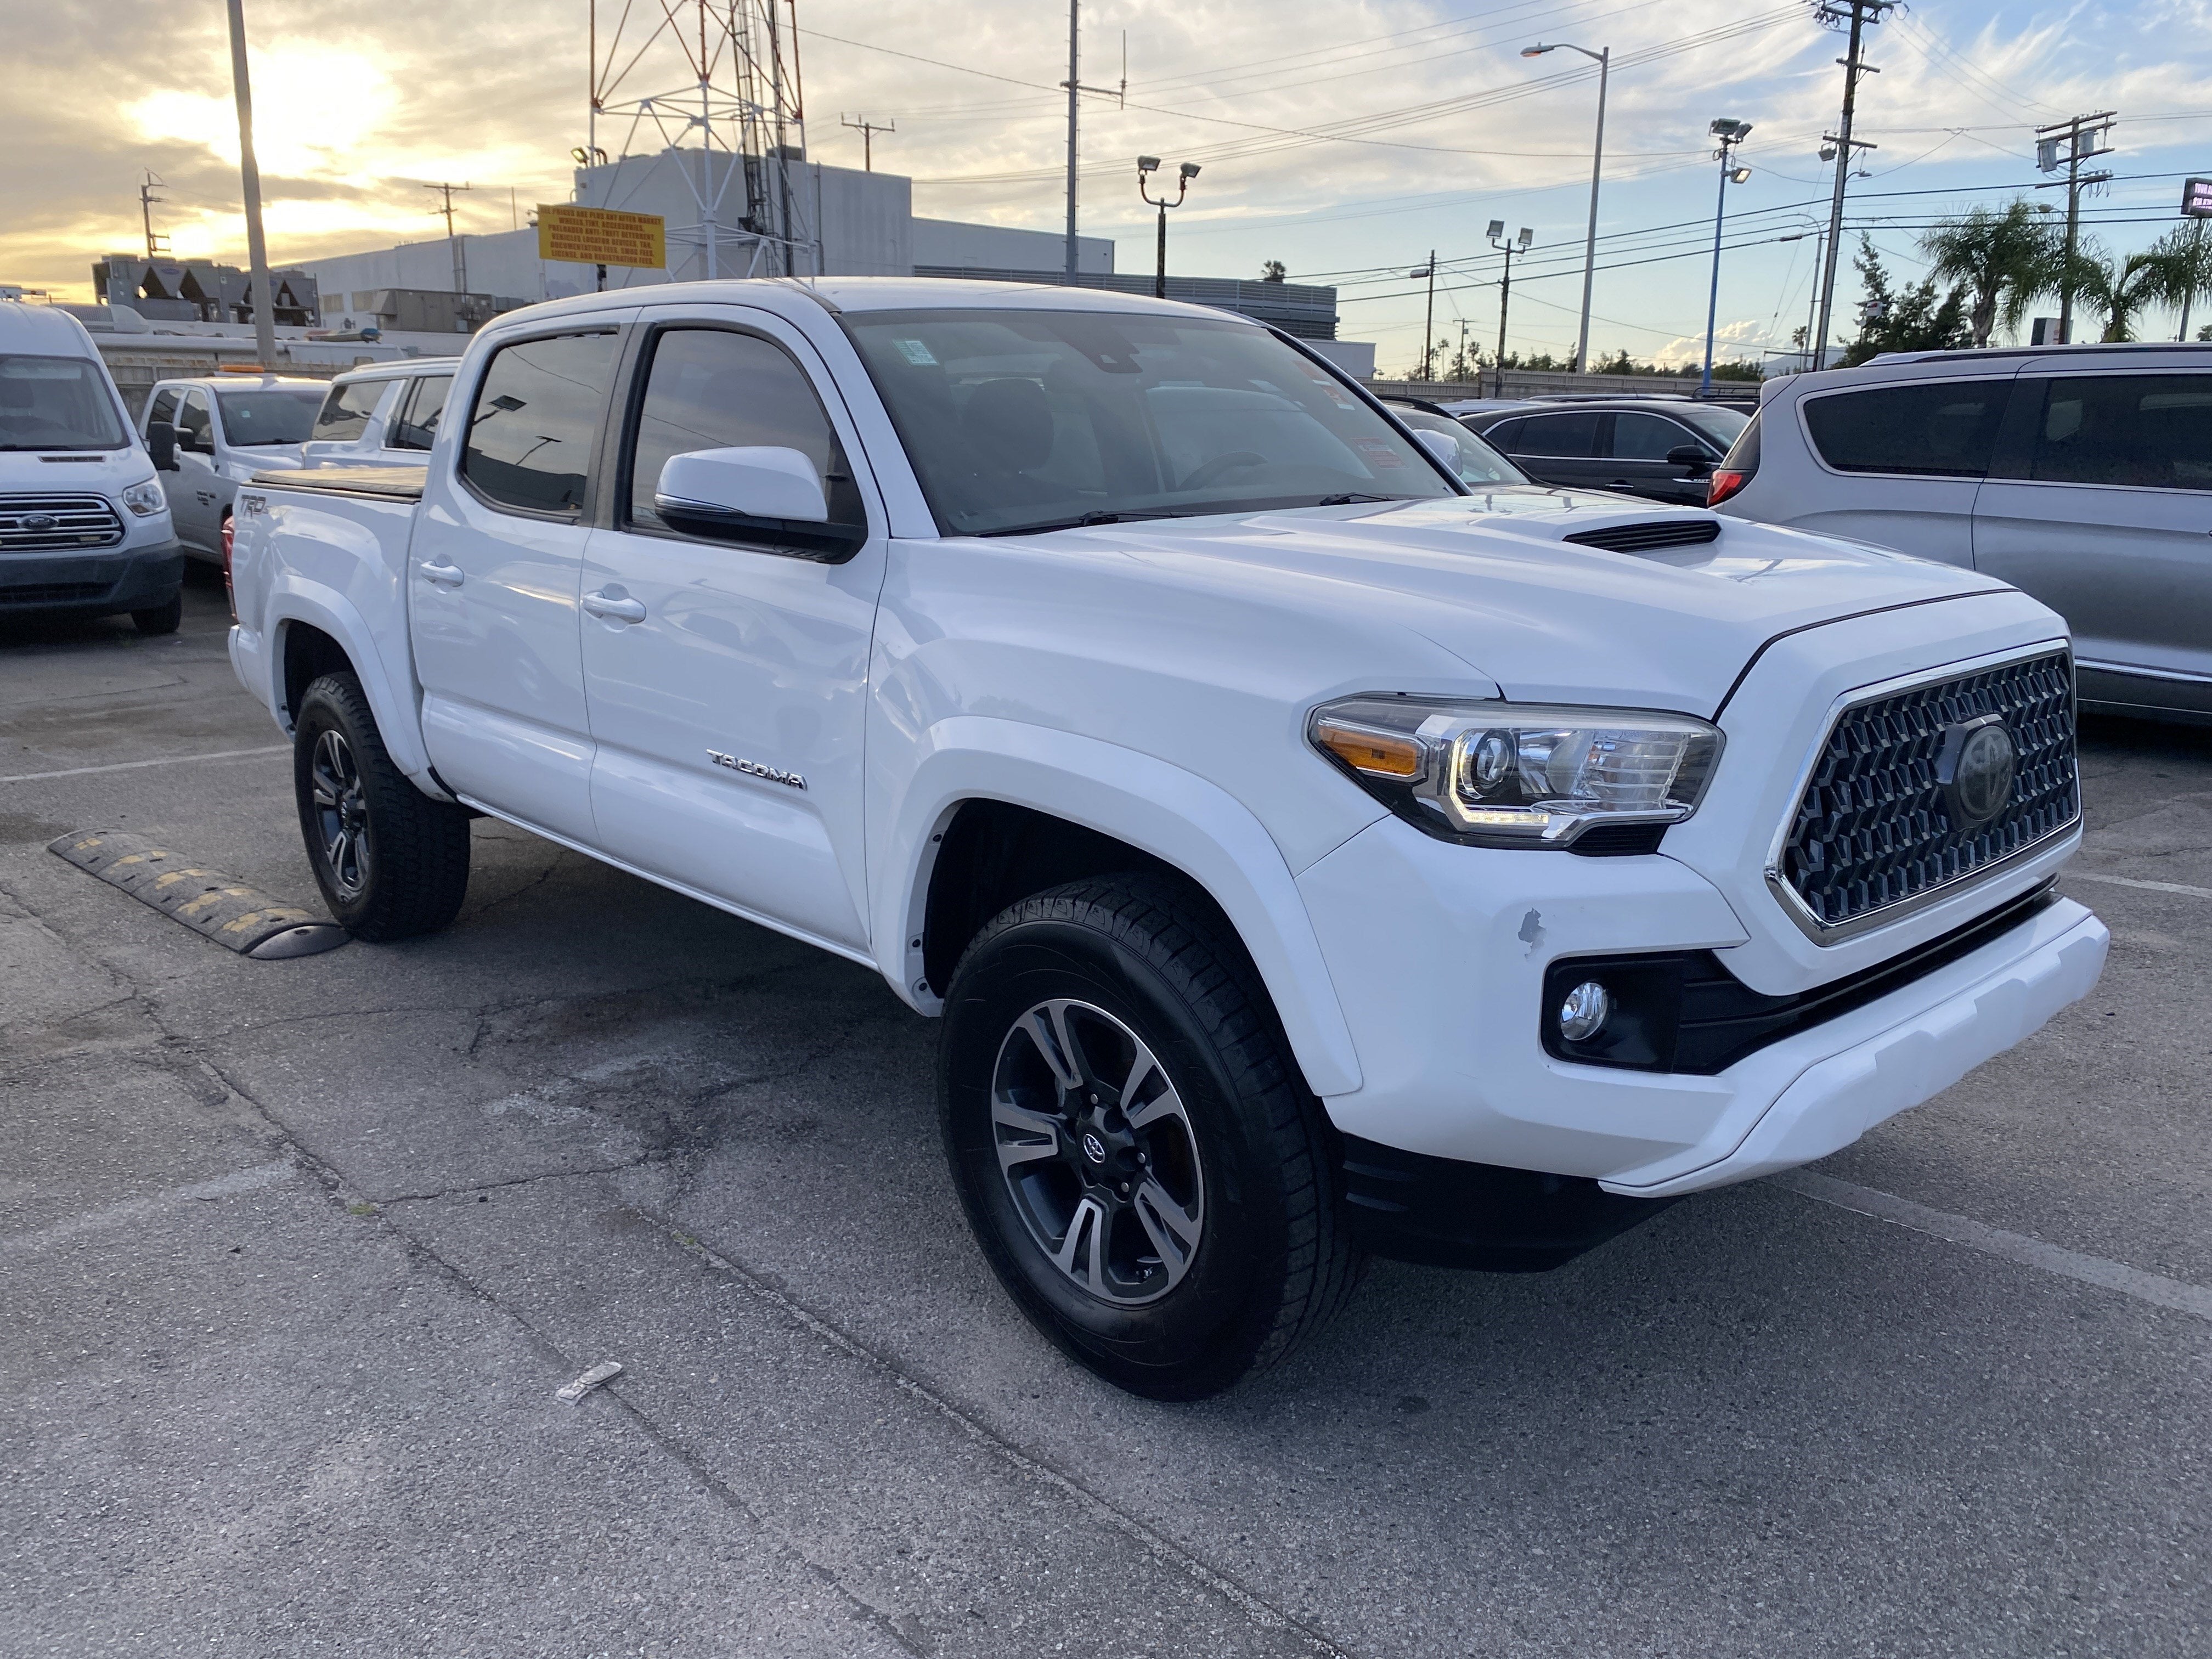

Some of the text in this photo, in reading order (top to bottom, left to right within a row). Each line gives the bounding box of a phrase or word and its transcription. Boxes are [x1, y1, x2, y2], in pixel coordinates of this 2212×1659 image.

[552, 208, 574, 216] PRICES
[589, 211, 603, 219] PLUS
[606, 213, 617, 221] ANY
[618, 215, 636, 223] AFTER
[638, 217, 661, 225] MARKET
[548, 224, 583, 234] PRELOADED
[585, 228, 620, 238] ANTI-THEFT
[550, 241, 602, 252] DOCUMENTATION
[583, 235, 610, 245] LOCATOR
[594, 253, 637, 263] REGISTRATION
[241, 494, 267, 519] TRD
[706, 748, 808, 791] TACOMA
